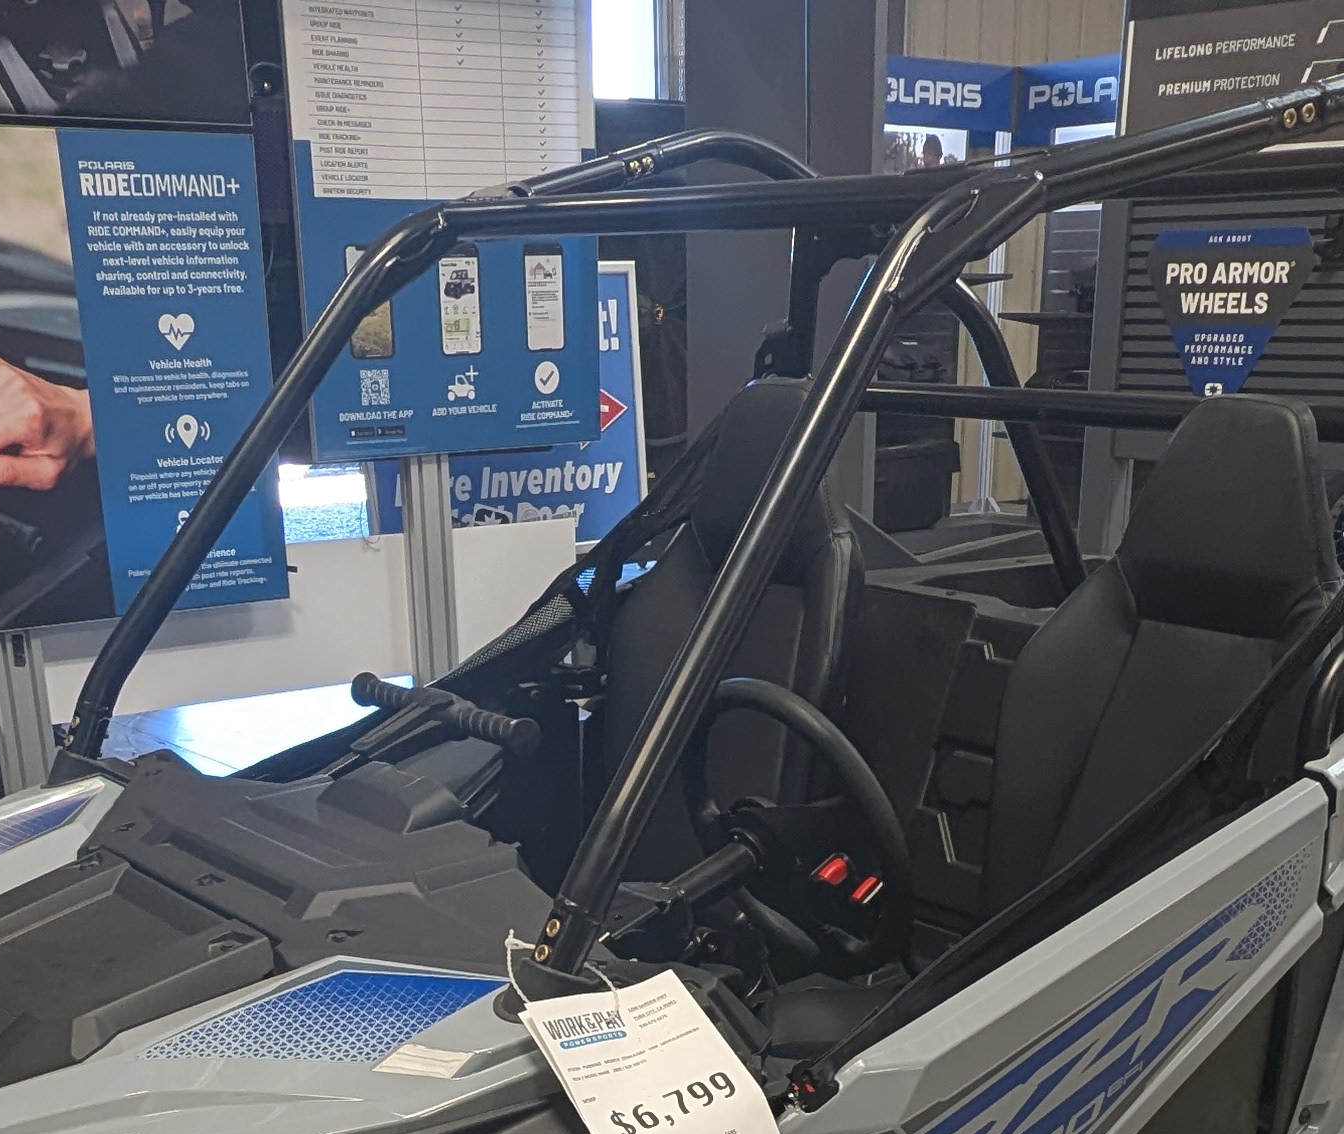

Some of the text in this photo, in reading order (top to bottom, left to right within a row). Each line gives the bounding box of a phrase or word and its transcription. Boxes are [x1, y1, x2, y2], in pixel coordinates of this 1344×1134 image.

[1155, 33, 1296, 60] LIFELONG PERFORMANCE
[1158, 73, 1280, 96] PREMIUM PROTECTION
[885, 77, 982, 108] OLARIS
[1028, 76, 1118, 109] POLA
[78, 160, 135, 170] POLARIS
[79, 173, 240, 197] RIDECOMMAND+
[93, 211, 238, 224] If not already pre-installed with
[88, 226, 110, 236] RIDE
[171, 226, 197, 238] easily
[199, 227, 224, 238] equip
[226, 228, 245, 238] your
[1208, 234, 1251, 243] ASK ABOUT
[87, 241, 121, 251] vehicle
[124, 241, 144, 251] with
[160, 242, 206, 253] accessory
[209, 241, 218, 250] to
[220, 240, 249, 250] unlock
[103, 254, 238, 266] next-level vehicle information
[96, 269, 247, 282] sharing, control and connectivity.
[1166, 262, 1207, 285] PRO
[103, 284, 244, 296] Available for up to 3-years free.
[1180, 292, 1269, 315] WHEELS
[1194, 333, 1244, 343] UPGRADED
[1184, 345, 1254, 354] PERFORMANCE
[149, 358, 212, 370] Vehicle Health
[1191, 356, 1244, 366] AND STYLE
[432, 403, 498, 417] ADD YOUR VEHICLE
[532, 399, 564, 410] ACTIVATE
[339, 409, 413, 422] DOWNLOAD THE APP
[520, 411, 536, 422] RIDE
[157, 455, 224, 468] Vehicle Locator
[480, 460, 623, 501] Inventory
[563, 1031, 624, 1048] POWERSPORTS
